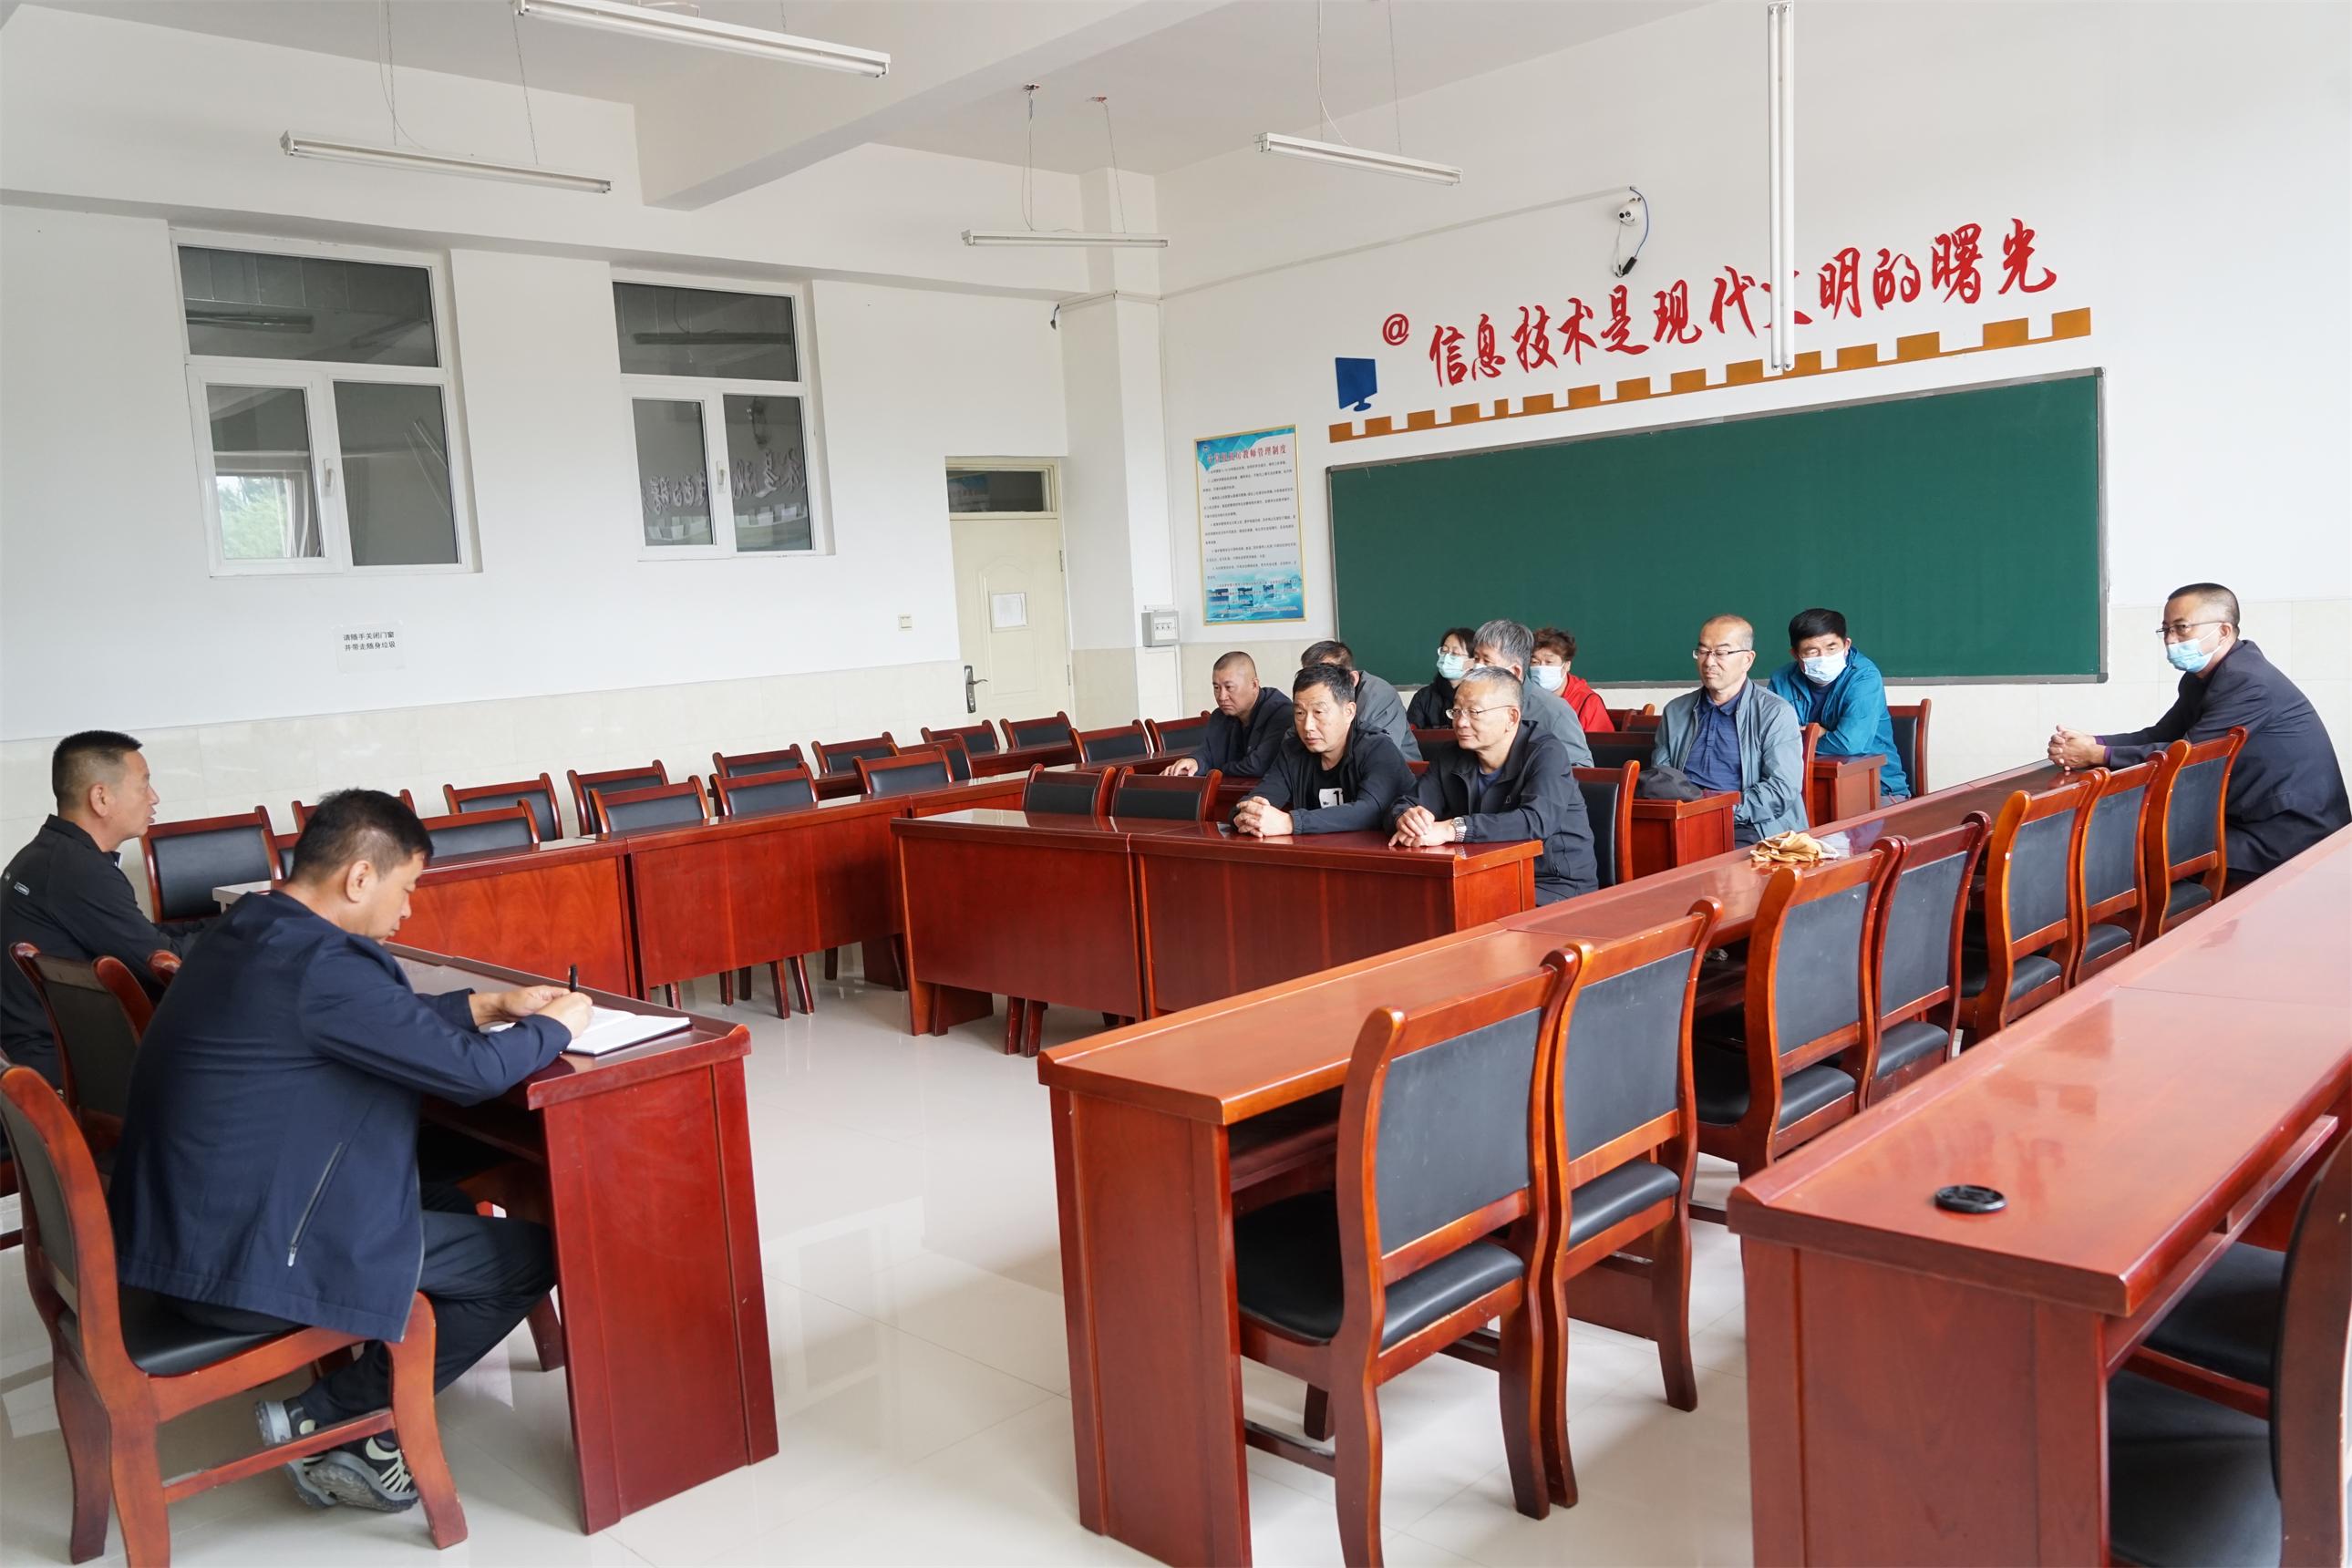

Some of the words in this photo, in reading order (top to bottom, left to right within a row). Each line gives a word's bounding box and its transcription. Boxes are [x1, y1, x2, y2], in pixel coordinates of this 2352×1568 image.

[343, 631, 395, 641] 请随手关闭门窗
[345, 641, 396, 652] 并带走随身垃圾
